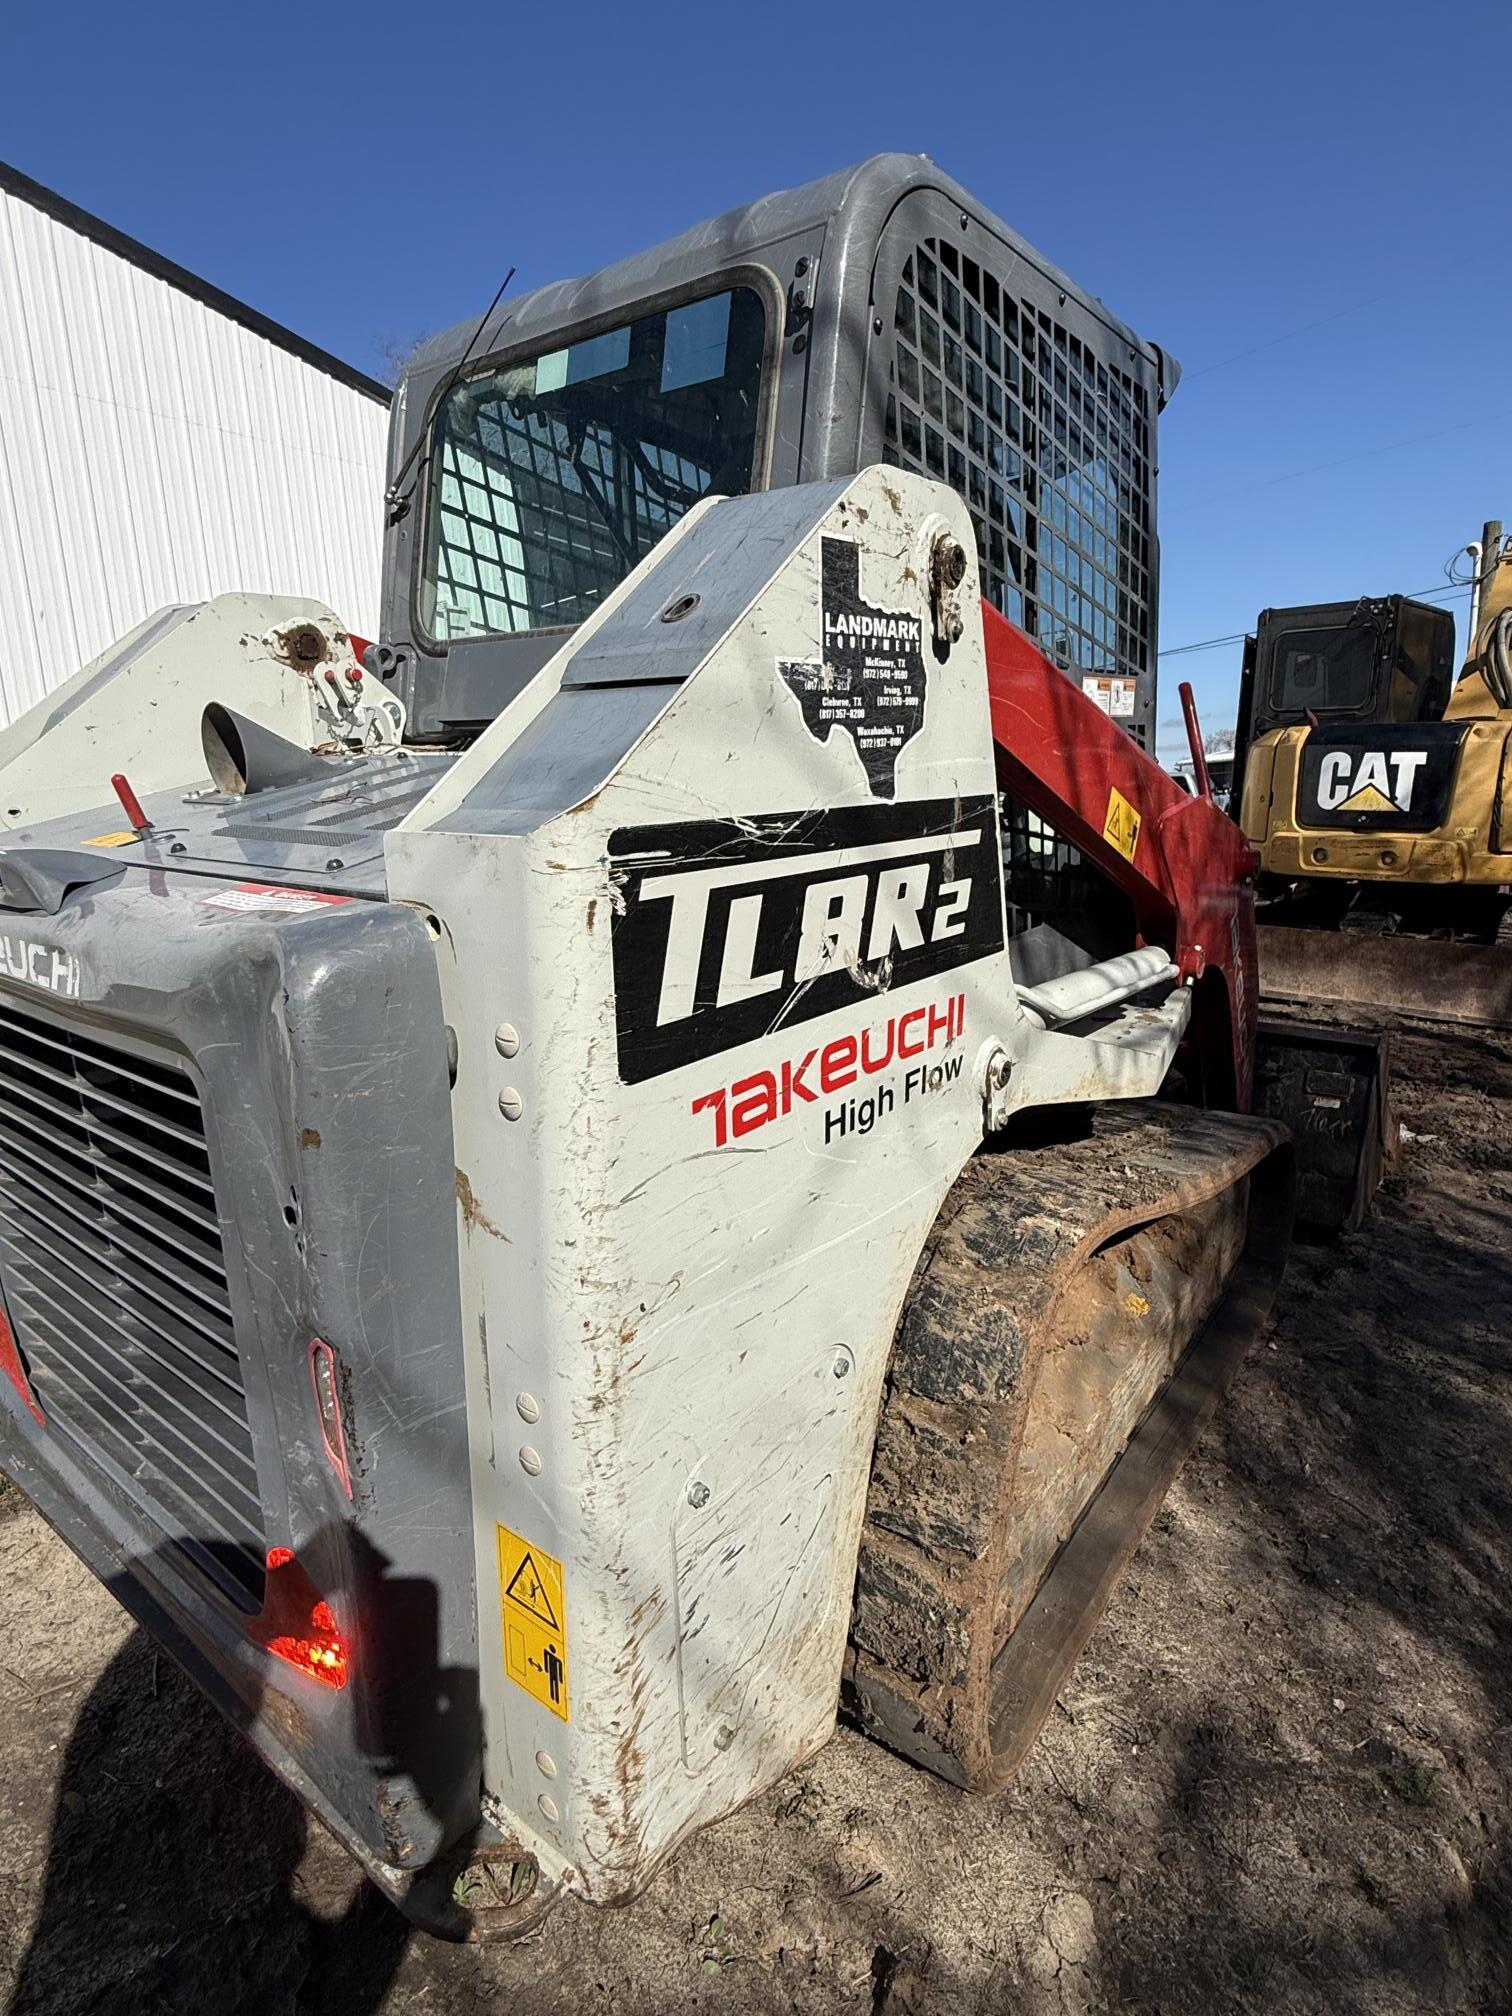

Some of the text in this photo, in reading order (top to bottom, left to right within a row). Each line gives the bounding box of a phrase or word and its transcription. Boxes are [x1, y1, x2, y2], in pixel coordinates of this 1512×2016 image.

[825, 612, 920, 641] LANDMARK
[825, 634, 920, 654] EQUIPMENT
[865, 656, 906, 669] McKinney, TX
[883, 684, 912, 697] Irving, TX
[852, 696, 862, 707] TX
[895, 724, 905, 735] TX
[1317, 751, 1428, 812] CAT
[824, 1054, 964, 1146] High Flow
